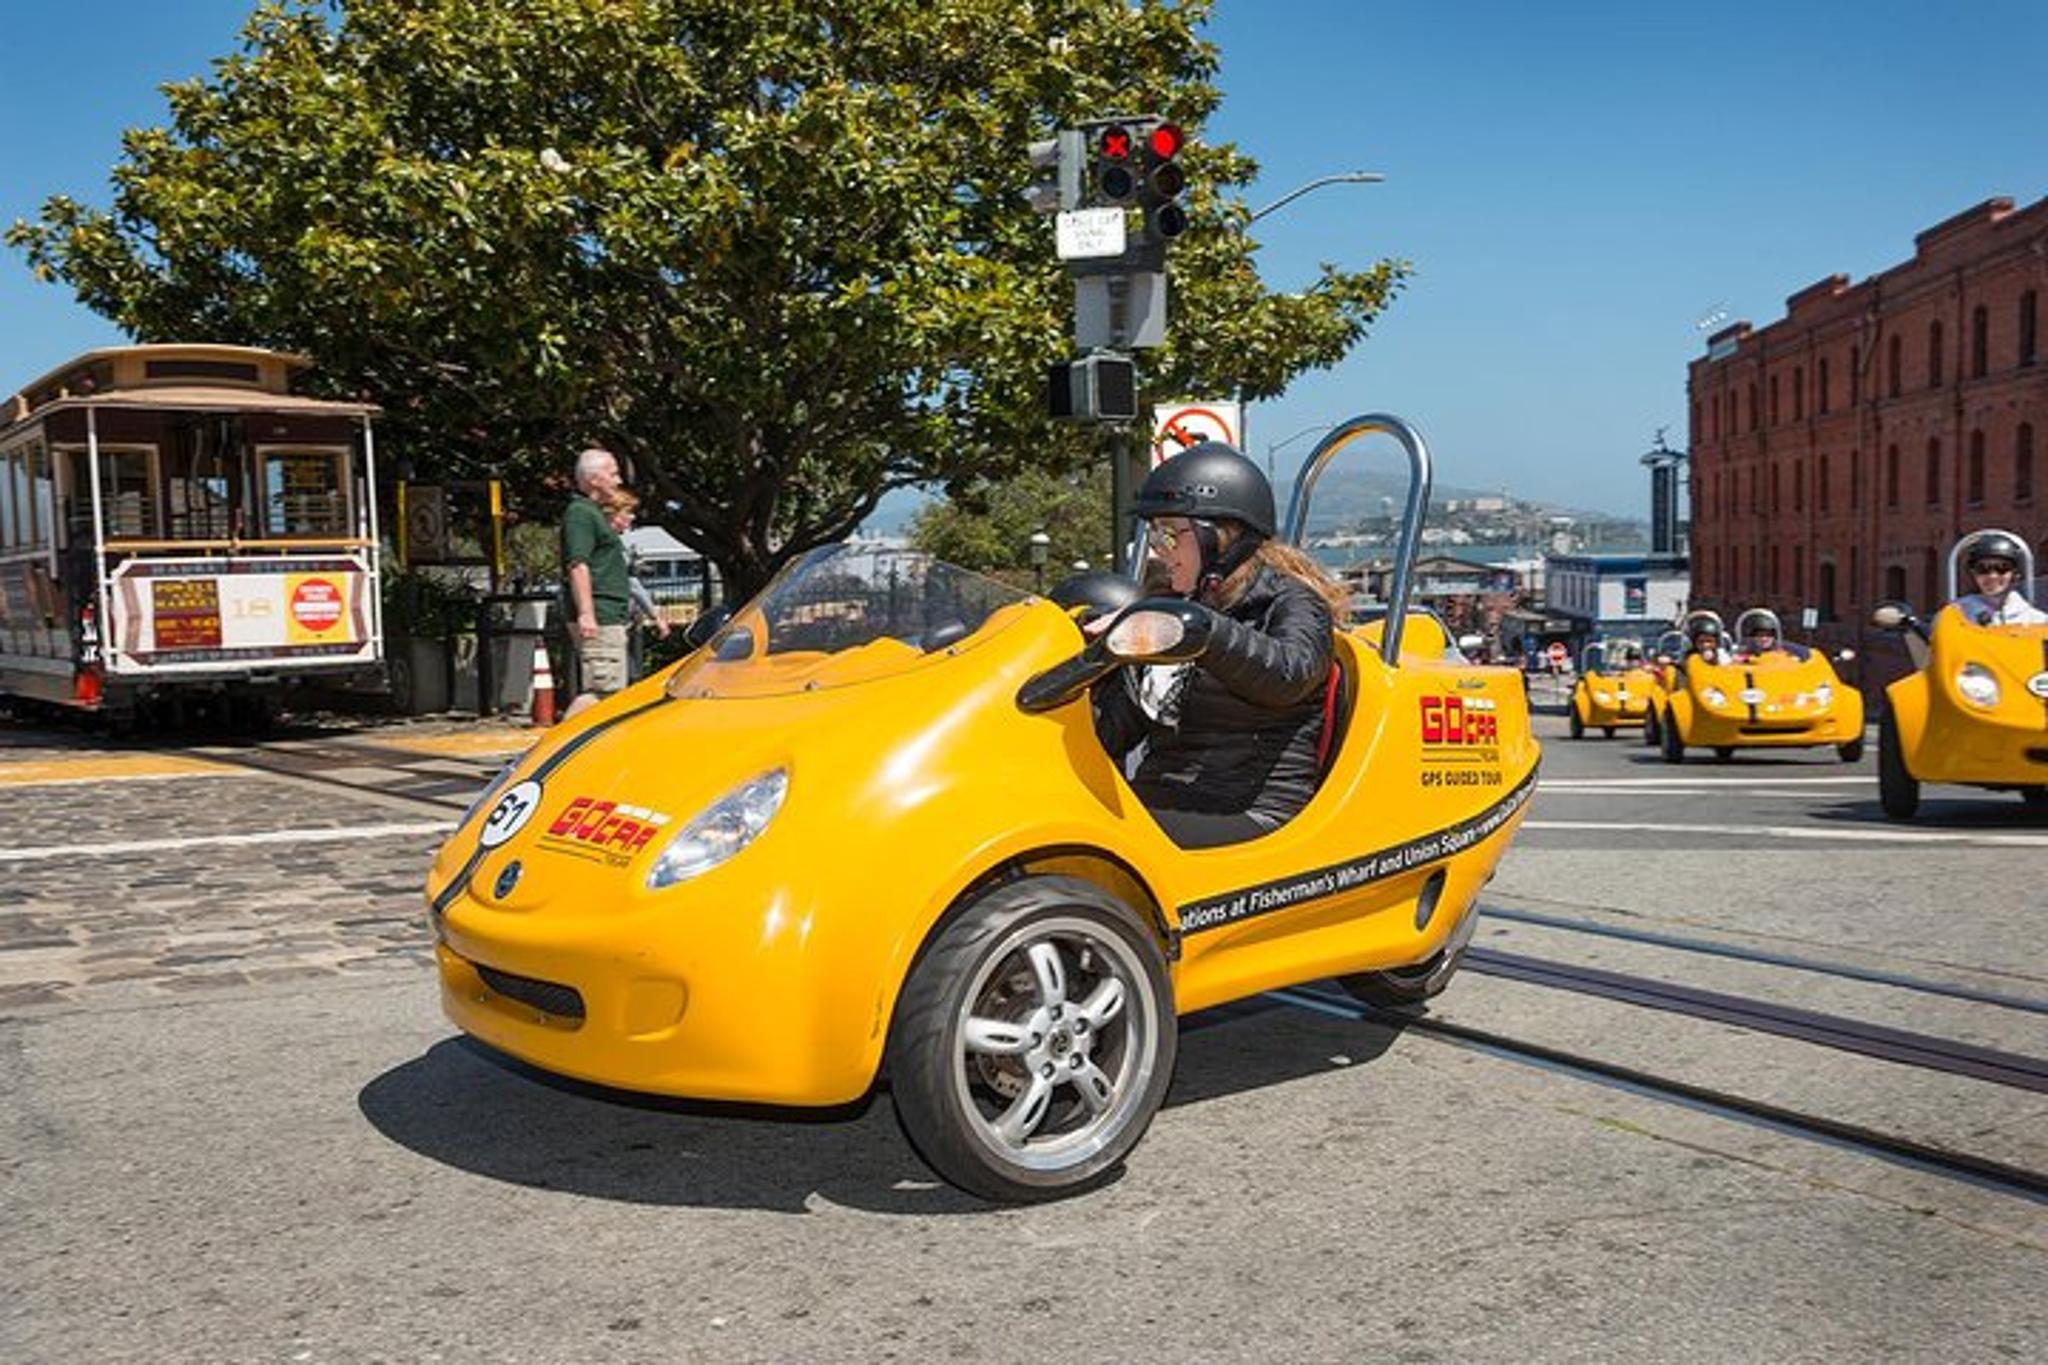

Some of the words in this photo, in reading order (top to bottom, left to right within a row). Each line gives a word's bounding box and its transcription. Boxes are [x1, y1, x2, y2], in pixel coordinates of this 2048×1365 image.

[1421, 770, 1442, 786] GPS
[1444, 770, 1479, 786] GUIDED
[486, 793, 530, 832] 61
[1229, 896, 1247, 917] at
[1249, 873, 1335, 911] Fisherman's
[1337, 858, 1377, 888] Wharf
[1379, 850, 1404, 875] and
[1404, 842, 1441, 866] Union
